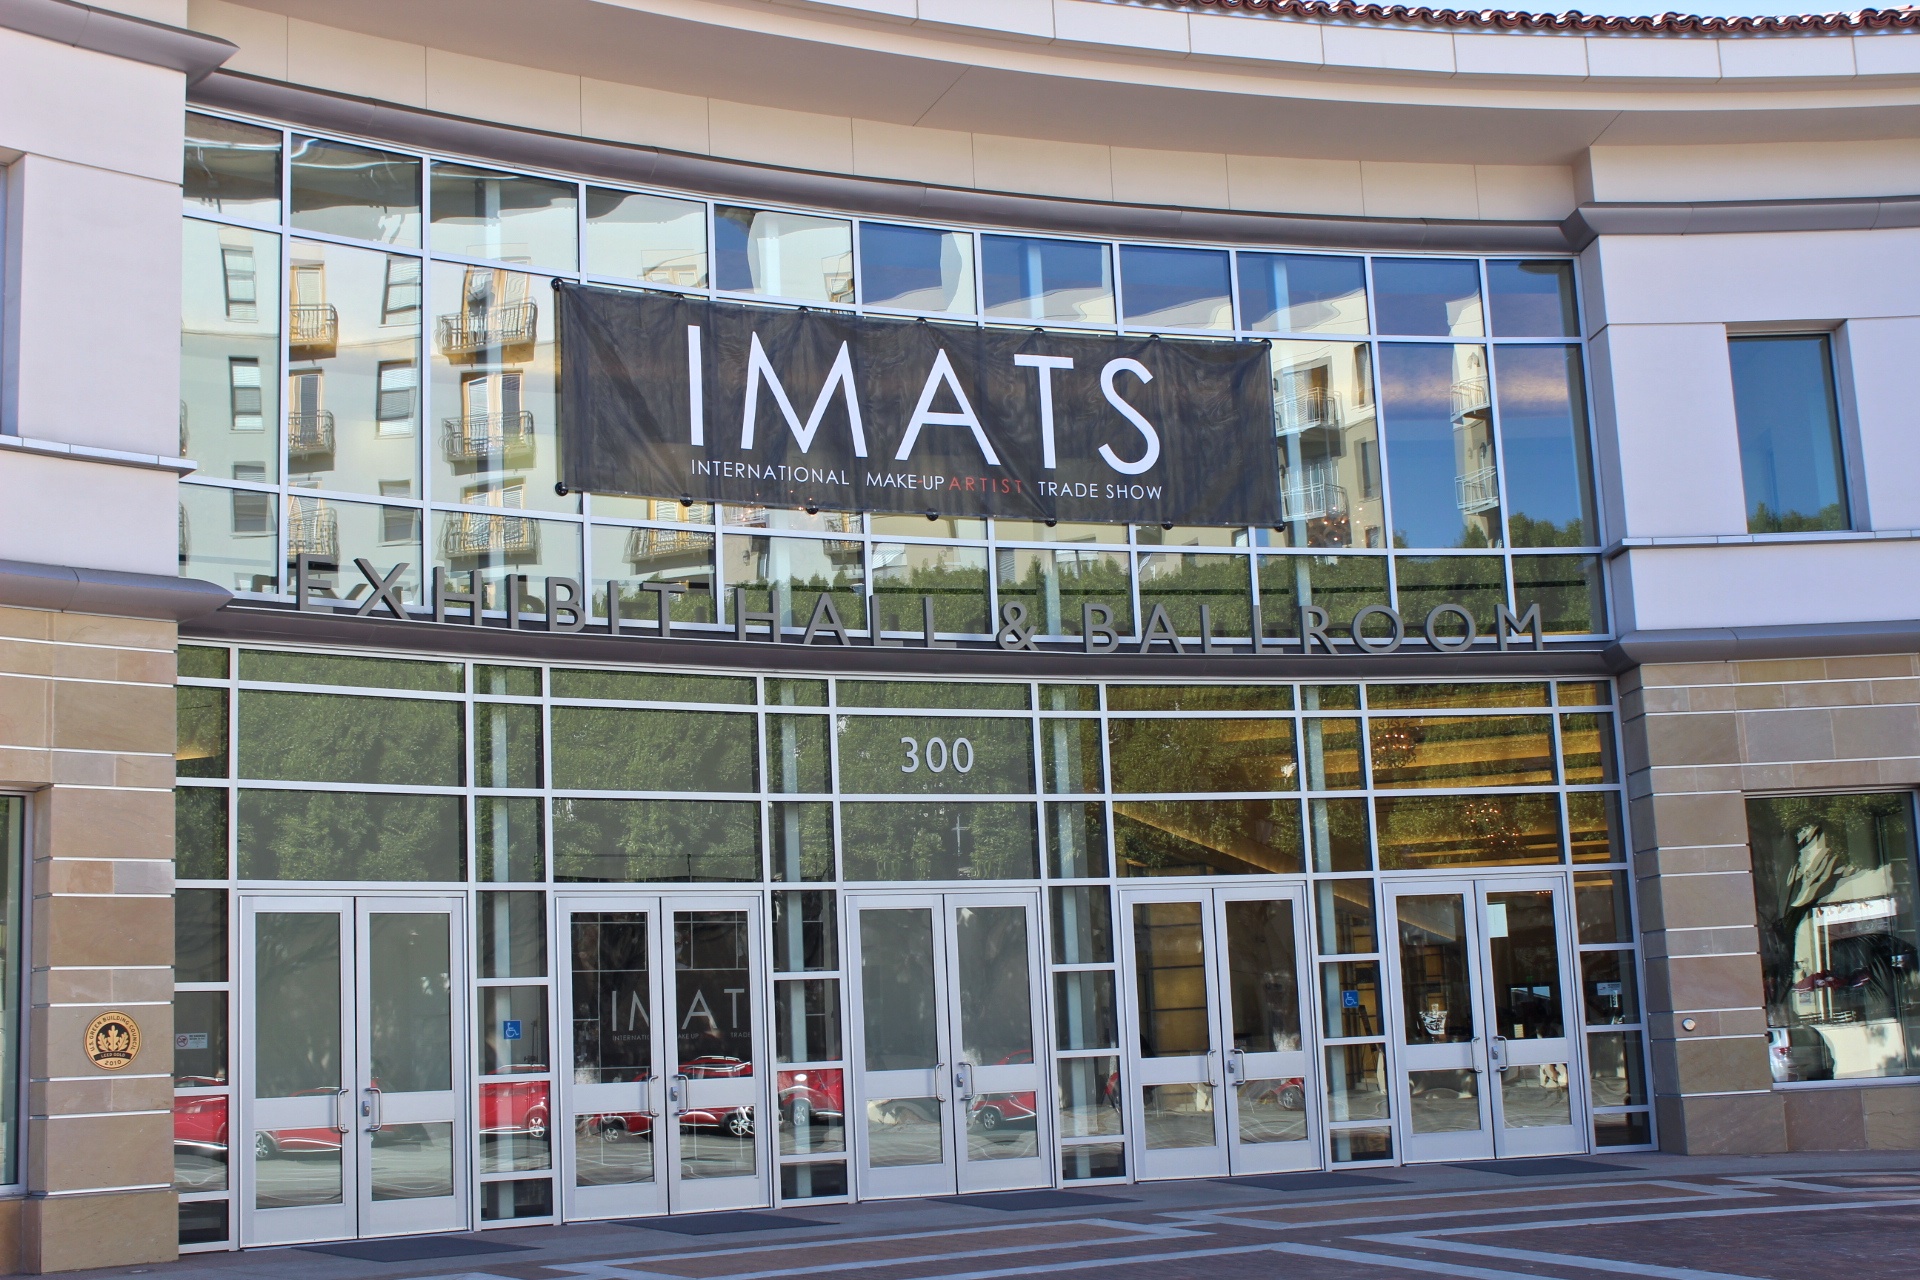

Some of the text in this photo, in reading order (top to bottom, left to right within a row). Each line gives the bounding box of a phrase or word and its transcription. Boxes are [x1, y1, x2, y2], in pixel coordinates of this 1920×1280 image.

[687, 325, 1161, 475] IMATS
[691, 459, 850, 486] INTERNATIONAL
[948, 477, 1022, 494] ARTIST
[1037, 481, 1099, 498] TRADE
[1105, 484, 1163, 500] SHOW
[296, 553, 1545, 655] EXHIBIT HALL & BALLROOM
[900, 736, 974, 774] 300
[89, 1020, 103, 1040] GREEN
[102, 1015, 130, 1026] BUILDING
[128, 1024, 138, 1050] COUNCIL
